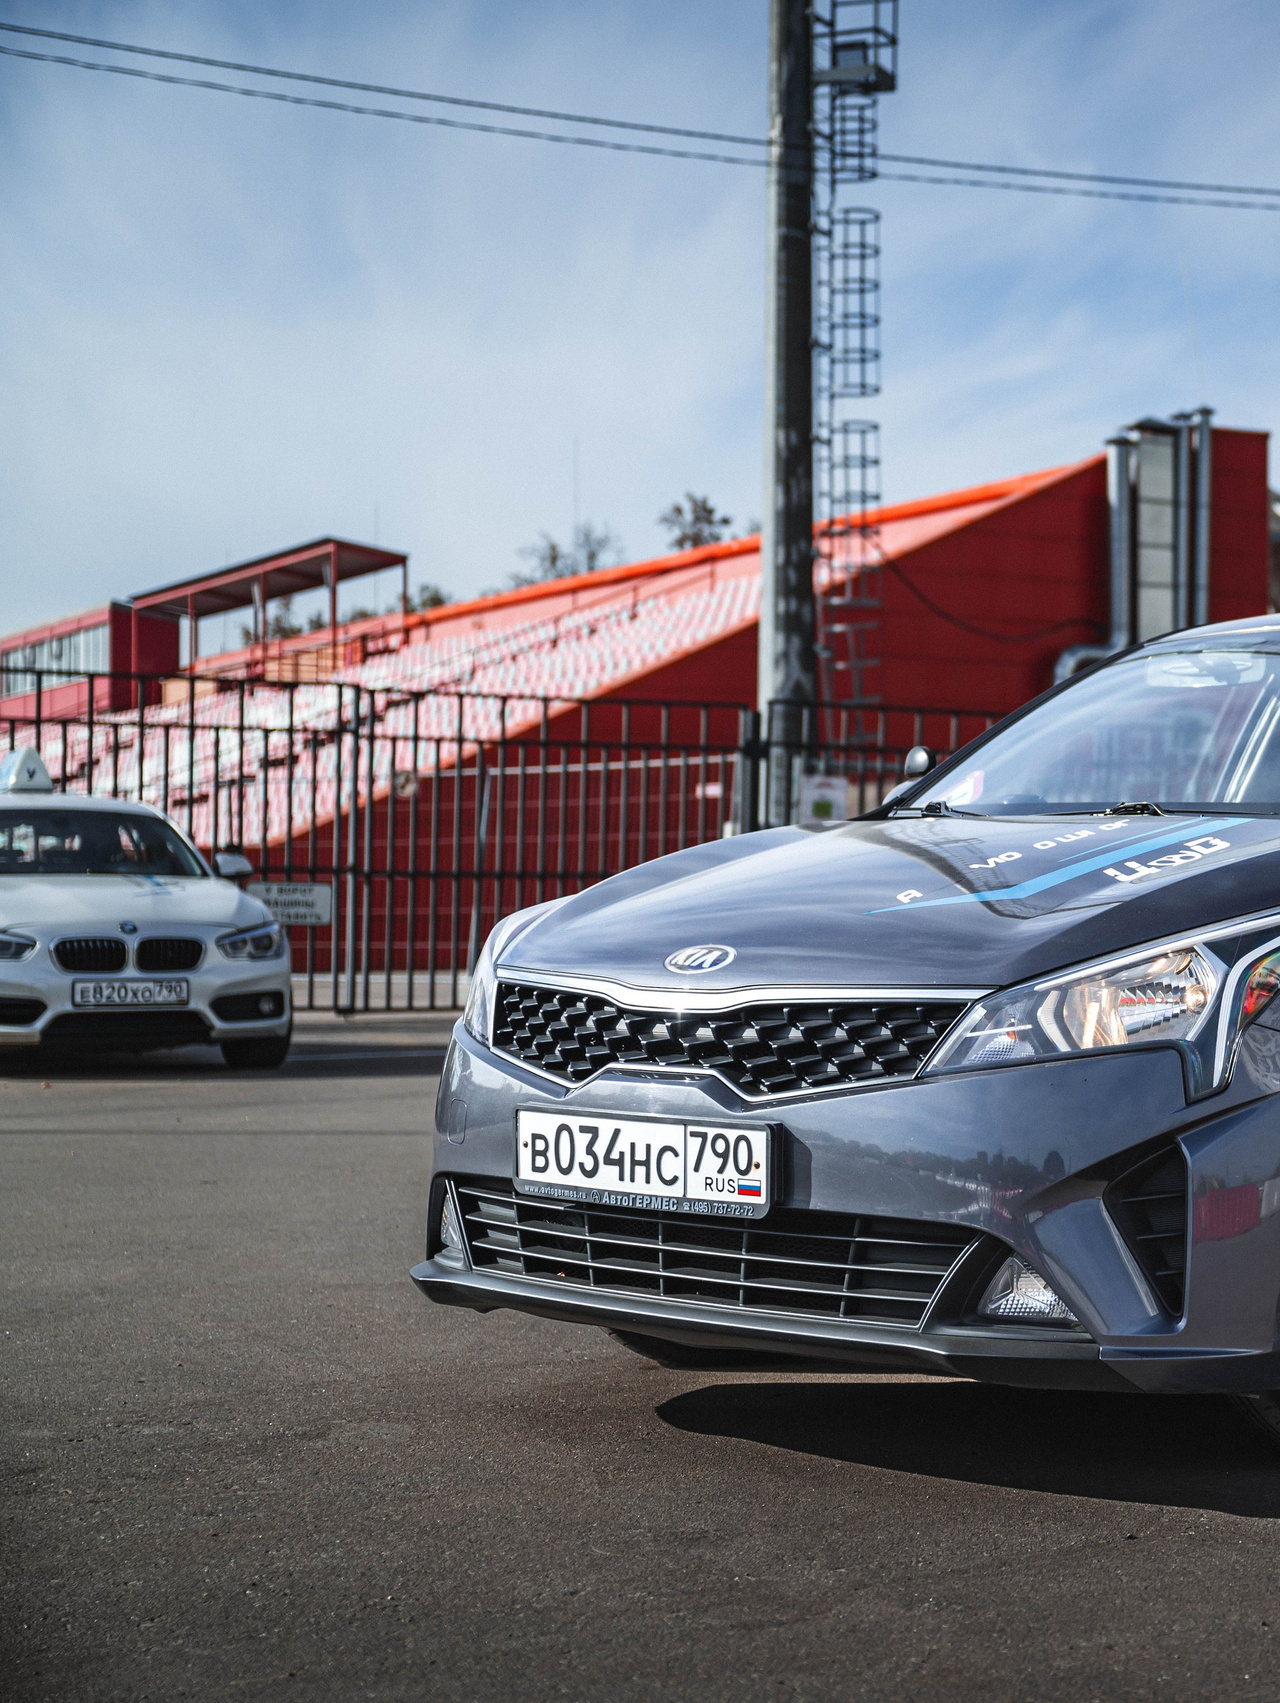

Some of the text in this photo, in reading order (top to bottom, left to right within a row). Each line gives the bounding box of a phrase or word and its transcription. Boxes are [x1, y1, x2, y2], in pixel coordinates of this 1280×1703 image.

[530, 1123, 753, 1186] В034НС 790
[523, 1183, 587, 1200] www.avtogermes.ru
[704, 1176, 736, 1194] RUS
[691, 1202, 755, 1217] (495) 737-72-72
